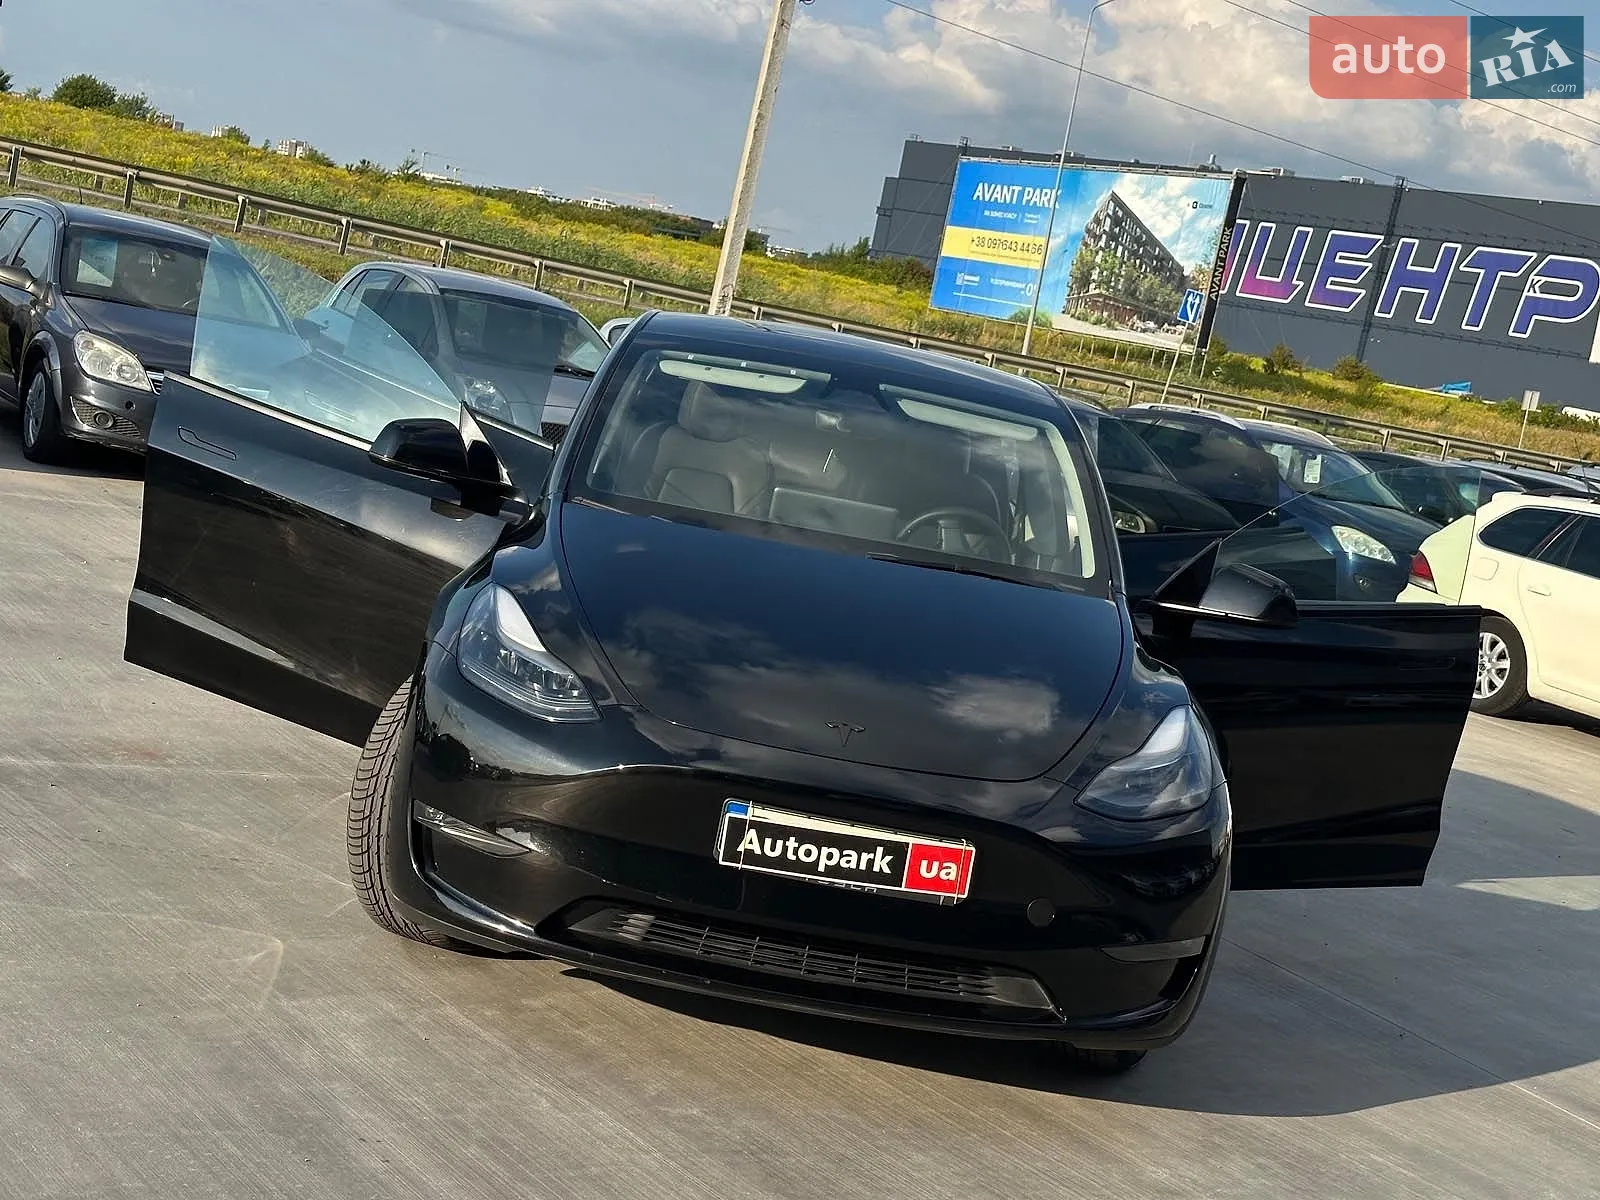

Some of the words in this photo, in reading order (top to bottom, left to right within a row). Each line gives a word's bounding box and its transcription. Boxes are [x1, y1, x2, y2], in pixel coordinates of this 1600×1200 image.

[972, 182, 1022, 205] AVANT
[1022, 187, 1062, 208] PARK
[1209, 258, 1225, 301] AVANT
[1218, 226, 1233, 259] PARK
[737, 828, 894, 874] Autopark
[919, 858, 959, 881] ua
